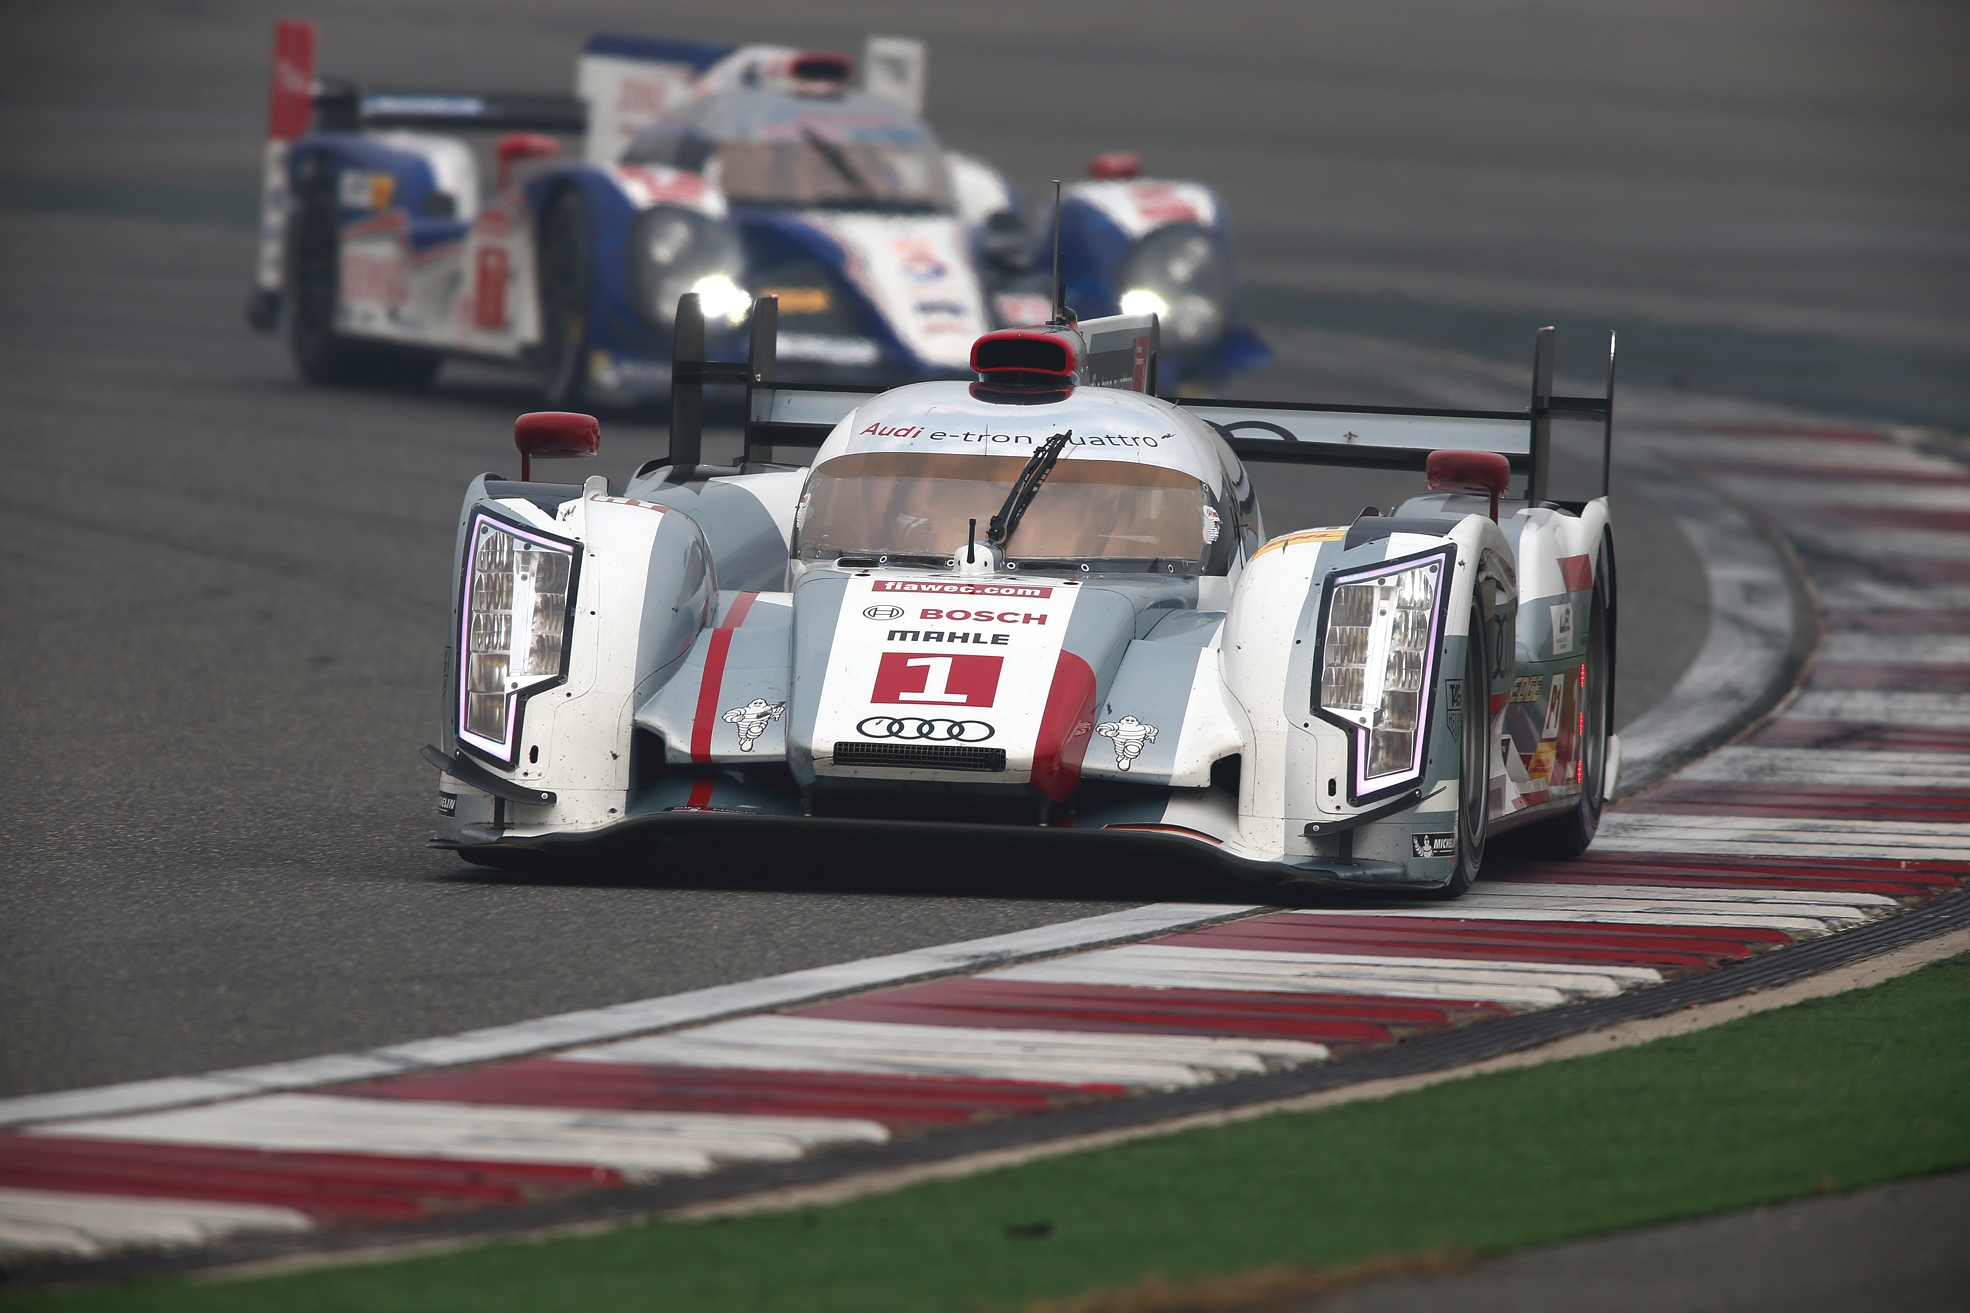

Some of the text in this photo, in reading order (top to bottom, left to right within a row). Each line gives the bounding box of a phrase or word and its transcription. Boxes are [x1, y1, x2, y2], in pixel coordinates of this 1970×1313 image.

[859, 421, 925, 439] Audi
[929, 431, 1033, 445] e-tron
[884, 581, 1041, 597] fiawec.com
[919, 608, 1048, 626] BOSCH
[887, 630, 1010, 646] MAHLE
[898, 656, 968, 703] 1
[1509, 674, 1544, 703] EDGE
[1546, 684, 1562, 730] P1
